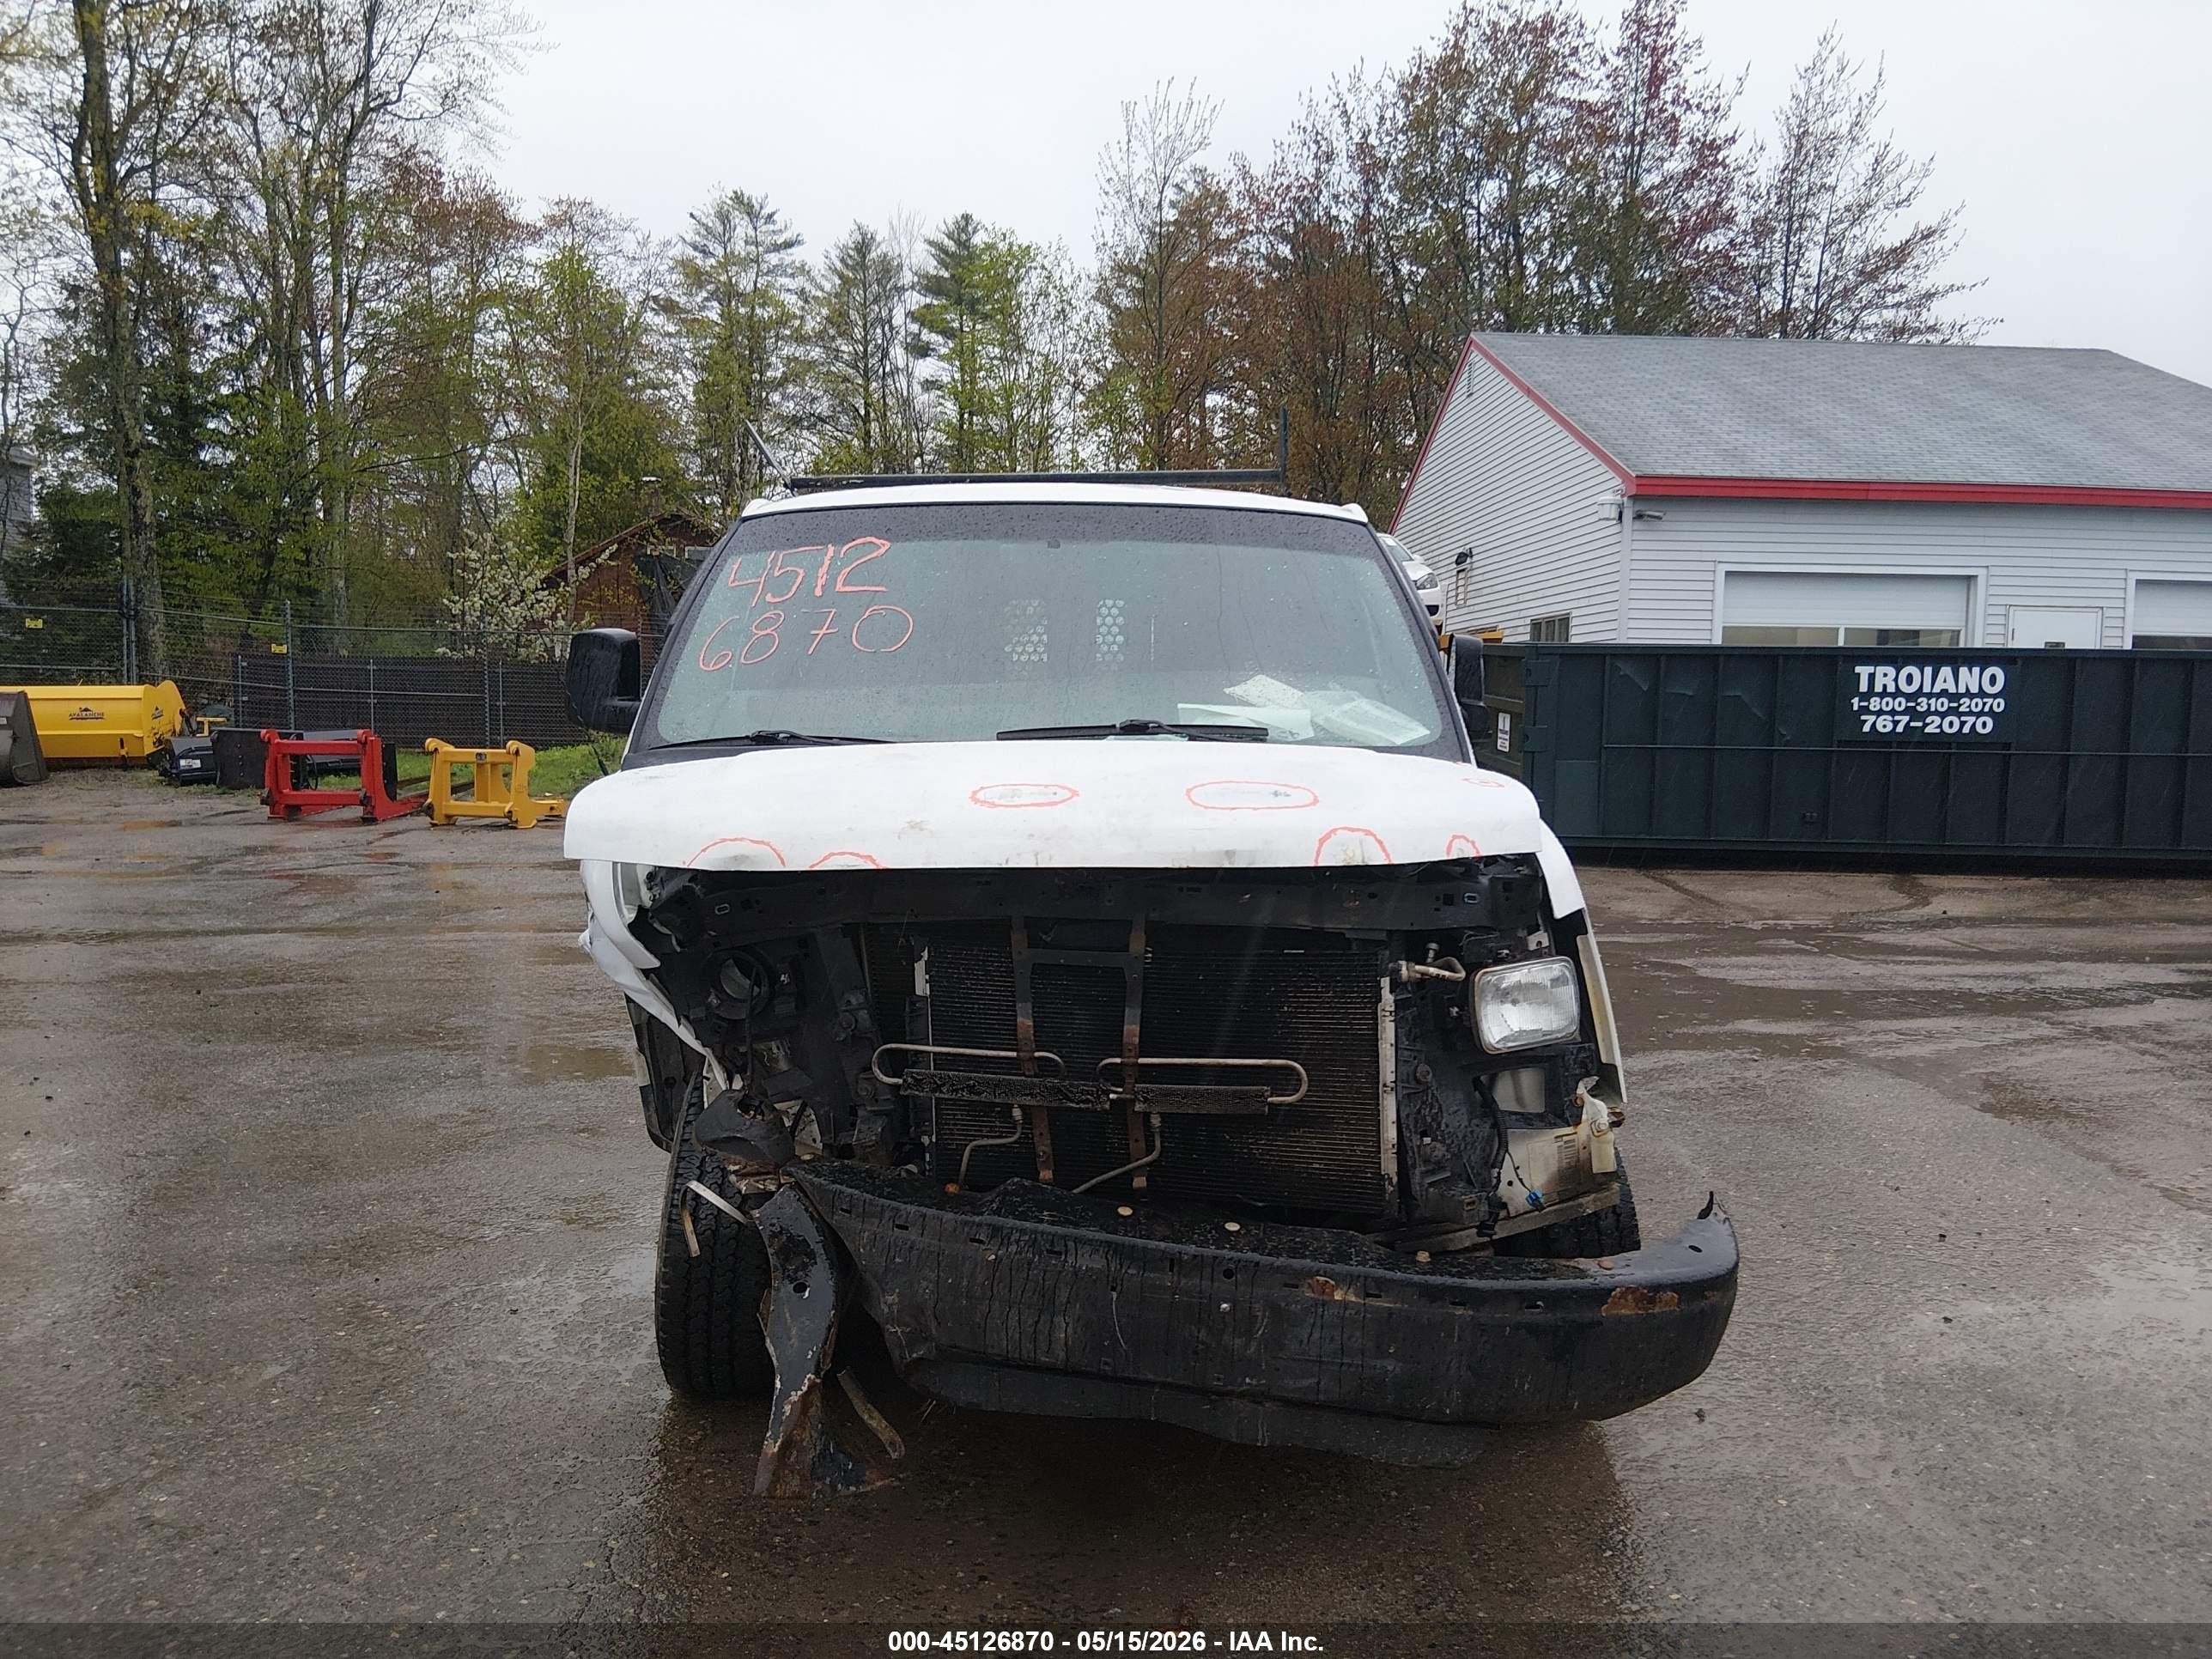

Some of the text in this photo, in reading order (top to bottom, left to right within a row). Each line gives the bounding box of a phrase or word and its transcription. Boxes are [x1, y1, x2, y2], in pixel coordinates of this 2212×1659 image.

[728, 537, 891, 606] 4512
[699, 605, 914, 671] 6870
[1854, 665, 2005, 694] TROIANO
[1850, 696, 2005, 712] 1-800-310-2070
[1860, 714, 1994, 734] 767-2070
